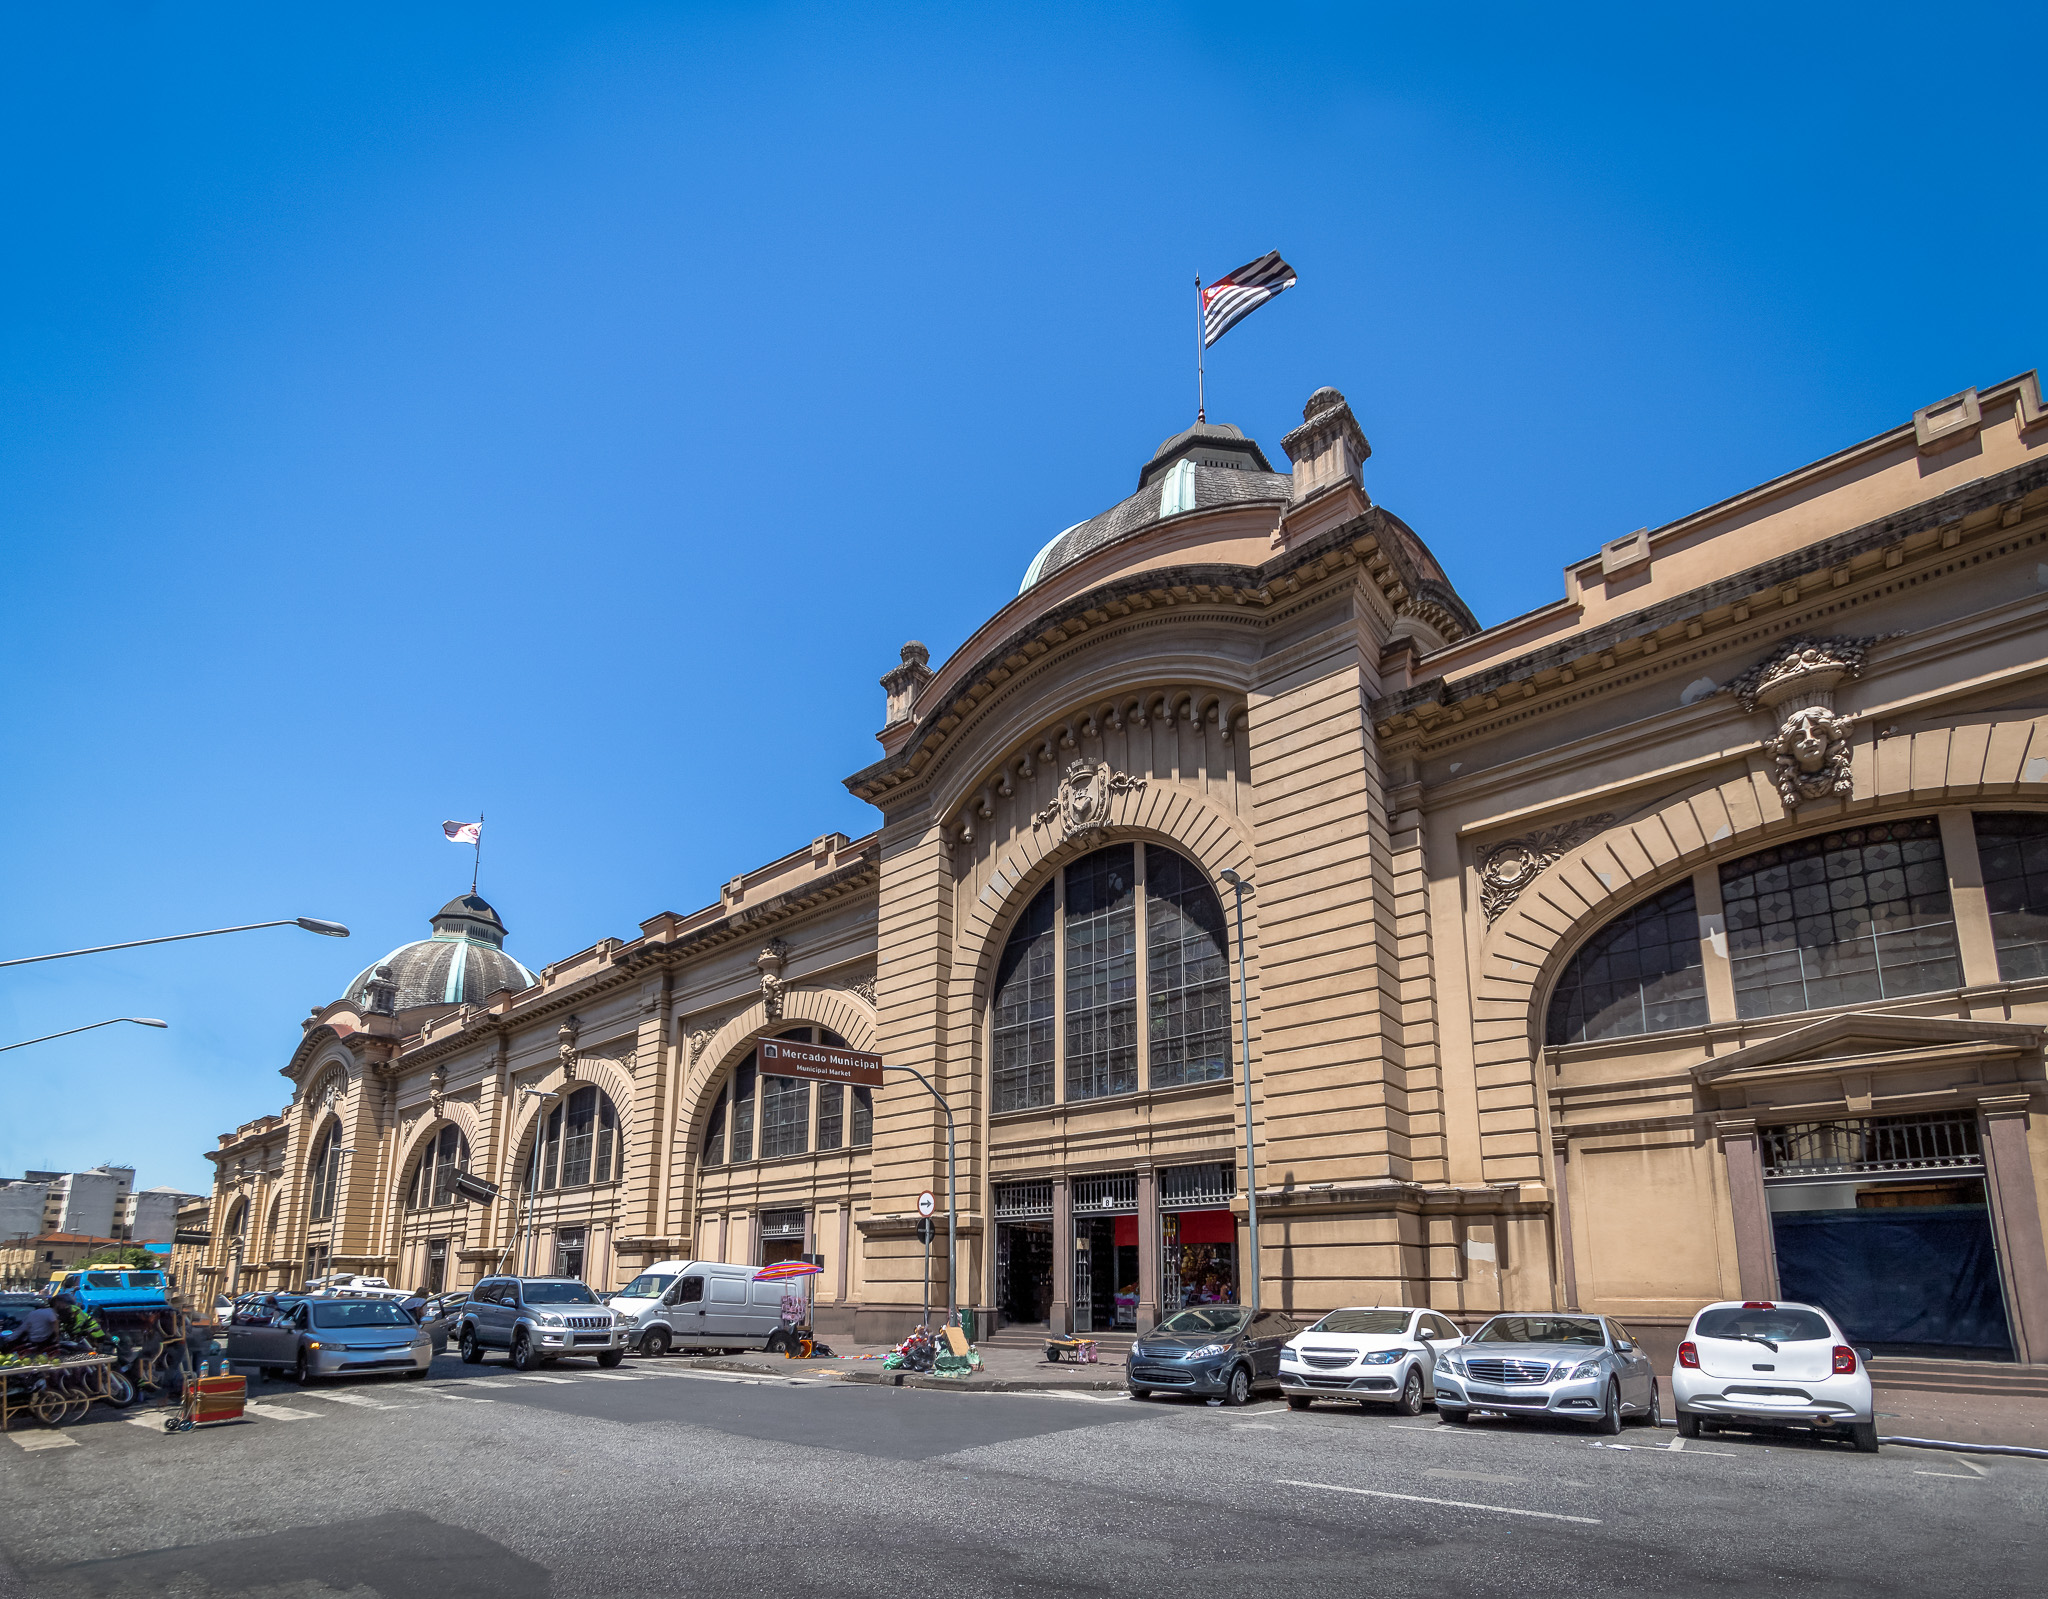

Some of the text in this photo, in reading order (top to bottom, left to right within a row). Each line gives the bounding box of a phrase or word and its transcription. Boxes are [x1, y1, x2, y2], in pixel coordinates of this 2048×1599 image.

[782, 1048, 879, 1070] Mercado Municipal
[796, 1064, 851, 1077] Municipal Market
